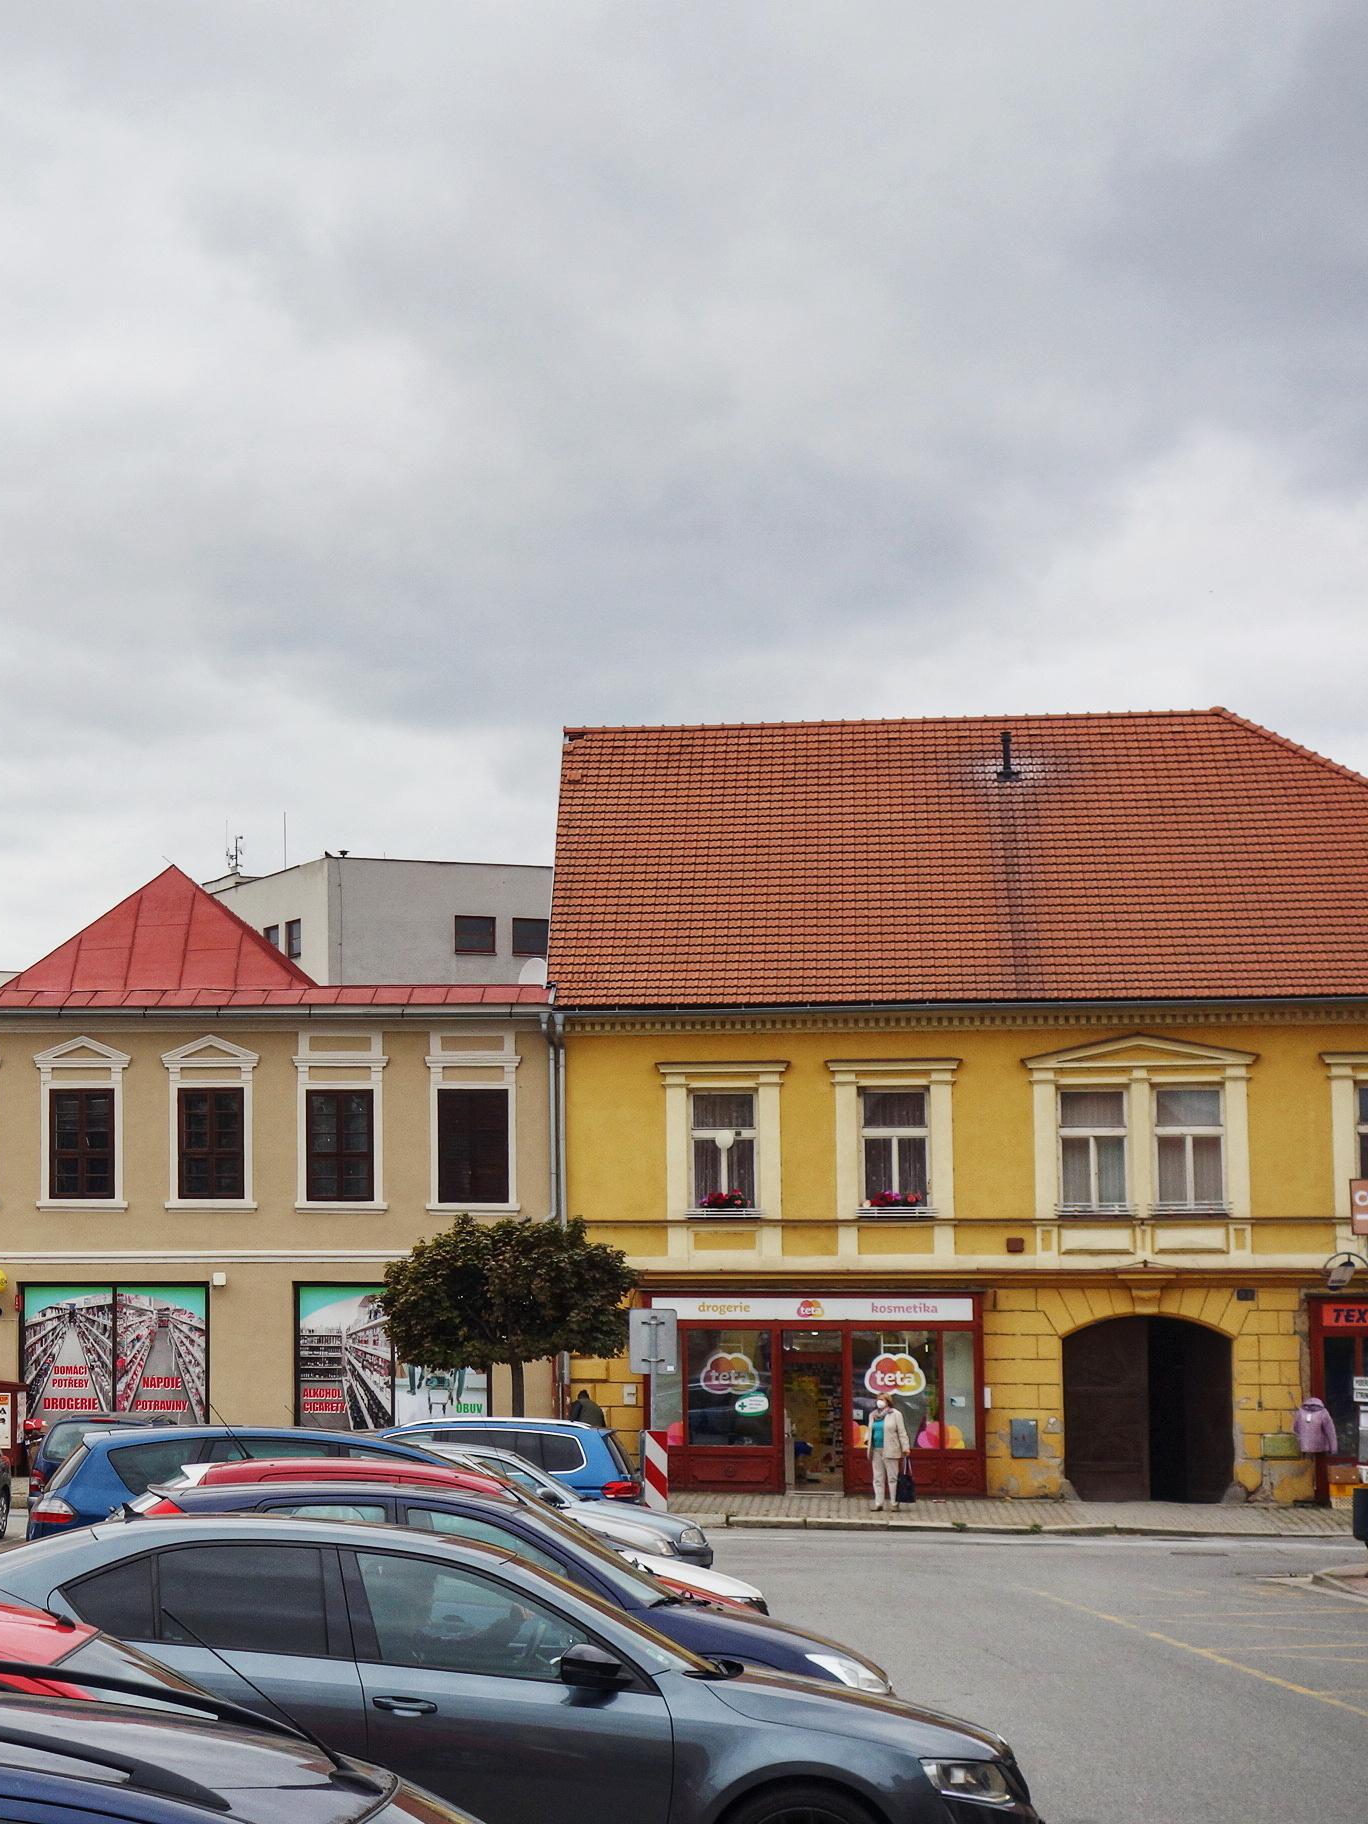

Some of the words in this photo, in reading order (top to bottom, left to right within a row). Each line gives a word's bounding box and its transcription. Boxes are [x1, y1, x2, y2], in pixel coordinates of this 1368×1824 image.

[698, 1302, 751, 1315] drogerie
[800, 1307, 823, 1315] teta
[871, 1302, 939, 1314] kosmetika
[52, 1377, 89, 1389] POTŘEBY
[142, 1374, 182, 1390] NÁPOJE
[710, 1369, 750, 1385] teta
[875, 1370, 917, 1387] teta
[303, 1388, 343, 1400] ALKOHOL
[43, 1398, 99, 1411] DROGERIE
[135, 1399, 189, 1412] POTRAVINY
[303, 1401, 347, 1413] CIGARETY
[456, 1403, 483, 1414] OBUV
